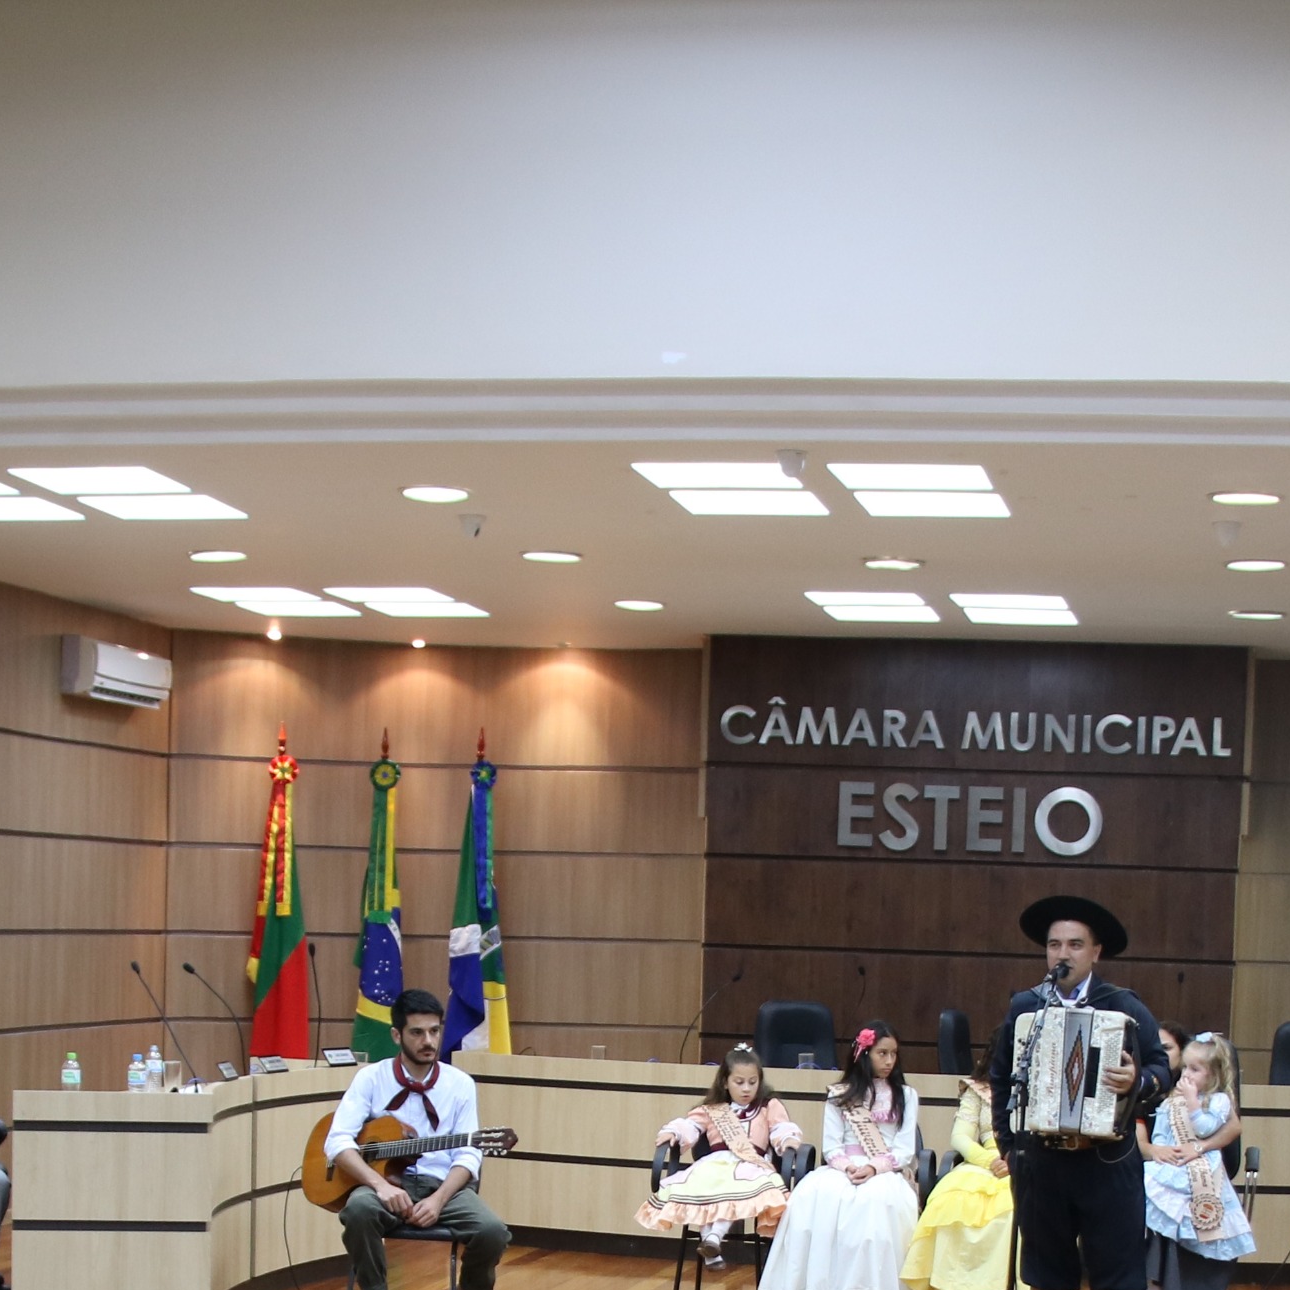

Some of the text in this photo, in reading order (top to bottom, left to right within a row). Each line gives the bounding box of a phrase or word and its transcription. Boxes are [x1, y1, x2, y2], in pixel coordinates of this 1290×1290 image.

[720, 696, 1232, 757] CÂMARA MUNICIPAL
[837, 781, 1103, 857] ESTEIO
